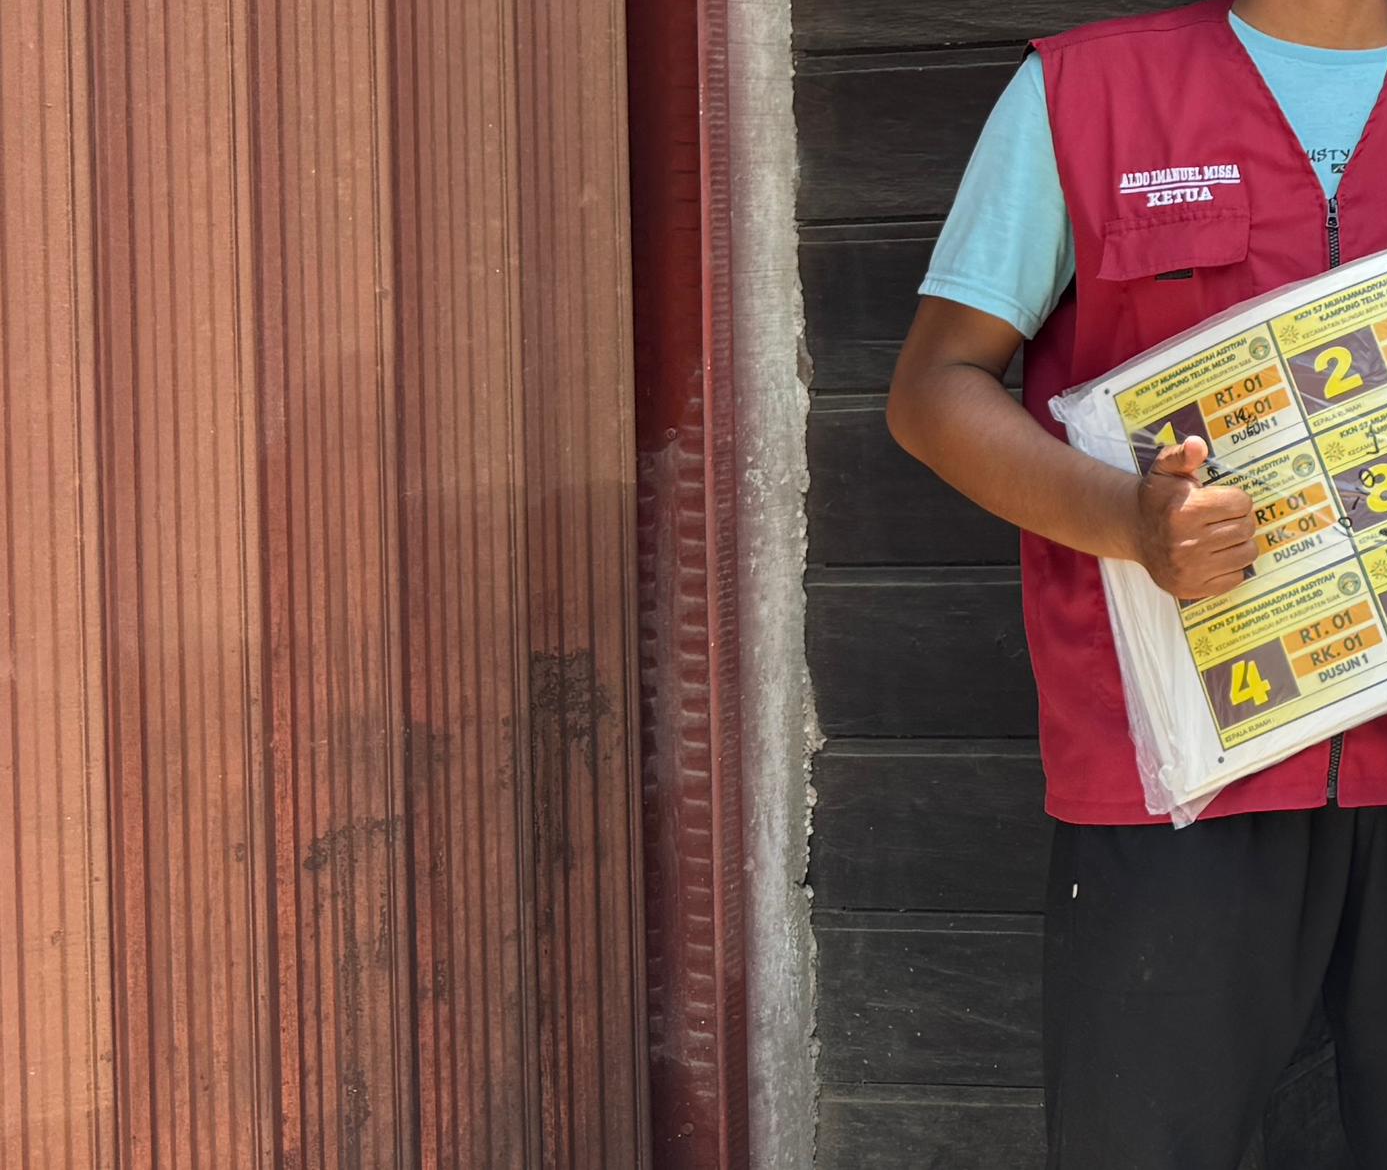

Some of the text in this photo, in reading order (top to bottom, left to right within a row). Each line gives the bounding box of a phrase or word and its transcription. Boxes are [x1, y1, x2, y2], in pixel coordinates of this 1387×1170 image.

[1120, 165, 1240, 188] ALDO IMANUEL MISSA
[1147, 187, 1213, 207] KETUA
[1214, 373, 1263, 407] RT. 01
[1317, 349, 1364, 399] 2
[1252, 395, 1272, 415] 01
[1270, 415, 1278, 426] 1
[1254, 490, 1308, 525] RT. 01
[1265, 513, 1317, 547] RK. 01
[1273, 533, 1323, 562] DUSUN 1
[1299, 609, 1353, 644] RT. 01
[1309, 632, 1363, 666] RK. 01
[1230, 660, 1271, 706] 4
[1318, 653, 1368, 682] DUSUN 1
